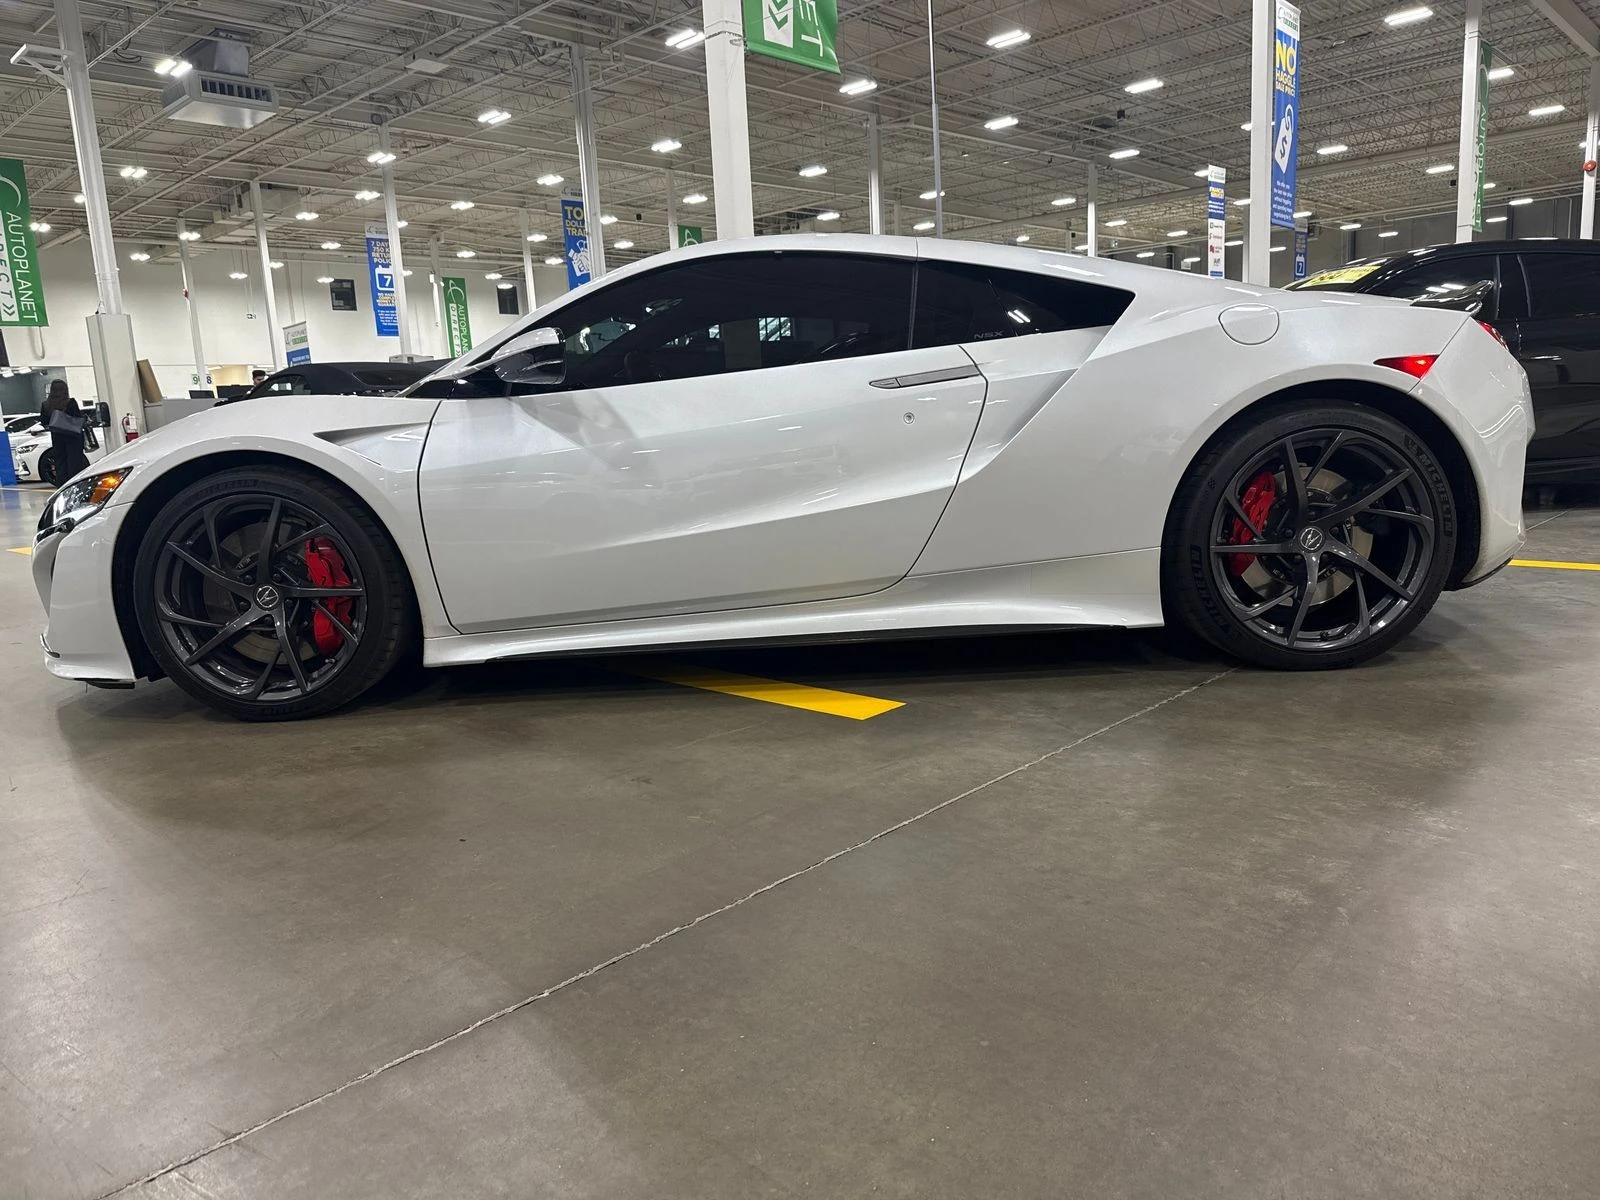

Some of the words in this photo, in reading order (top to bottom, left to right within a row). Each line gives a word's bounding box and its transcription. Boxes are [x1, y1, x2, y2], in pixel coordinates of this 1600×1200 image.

[1276, 40, 1296, 76] NO
[6, 211, 39, 323] AUTOPLANET
[1298, 263, 1303, 273] 7
[384, 276, 392, 287] 7
[451, 305, 460, 348] DIRECT
[973, 330, 1004, 340] NSX
[192, 376, 199, 385] 9
[206, 375, 212, 384] 8
[1418, 453, 1454, 534] MICHELIN
